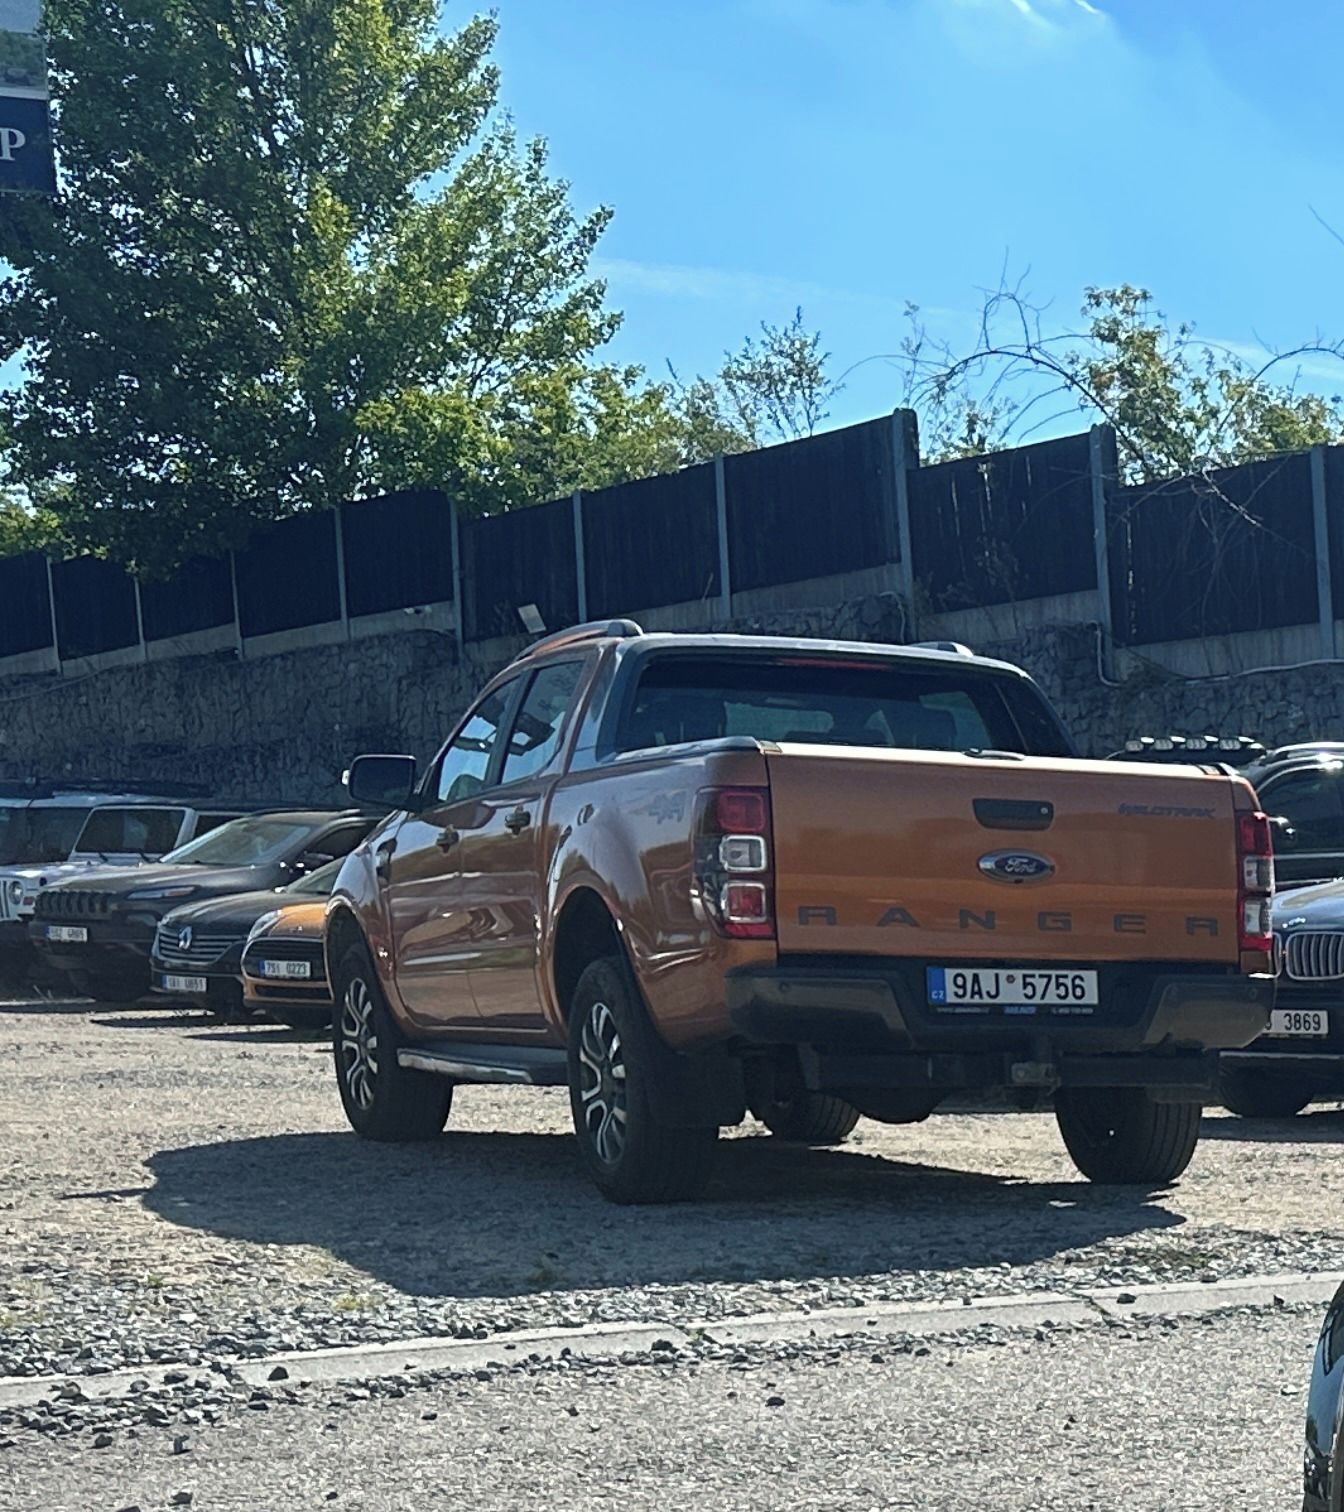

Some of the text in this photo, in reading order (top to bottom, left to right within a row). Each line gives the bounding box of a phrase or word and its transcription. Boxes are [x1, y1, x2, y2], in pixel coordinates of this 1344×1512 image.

[1004, 857, 1037, 874] Ford
[797, 904, 1219, 938] RANGER
[952, 972, 1086, 1001] 9AJ 5756
[1283, 1012, 1321, 1032] 3869
